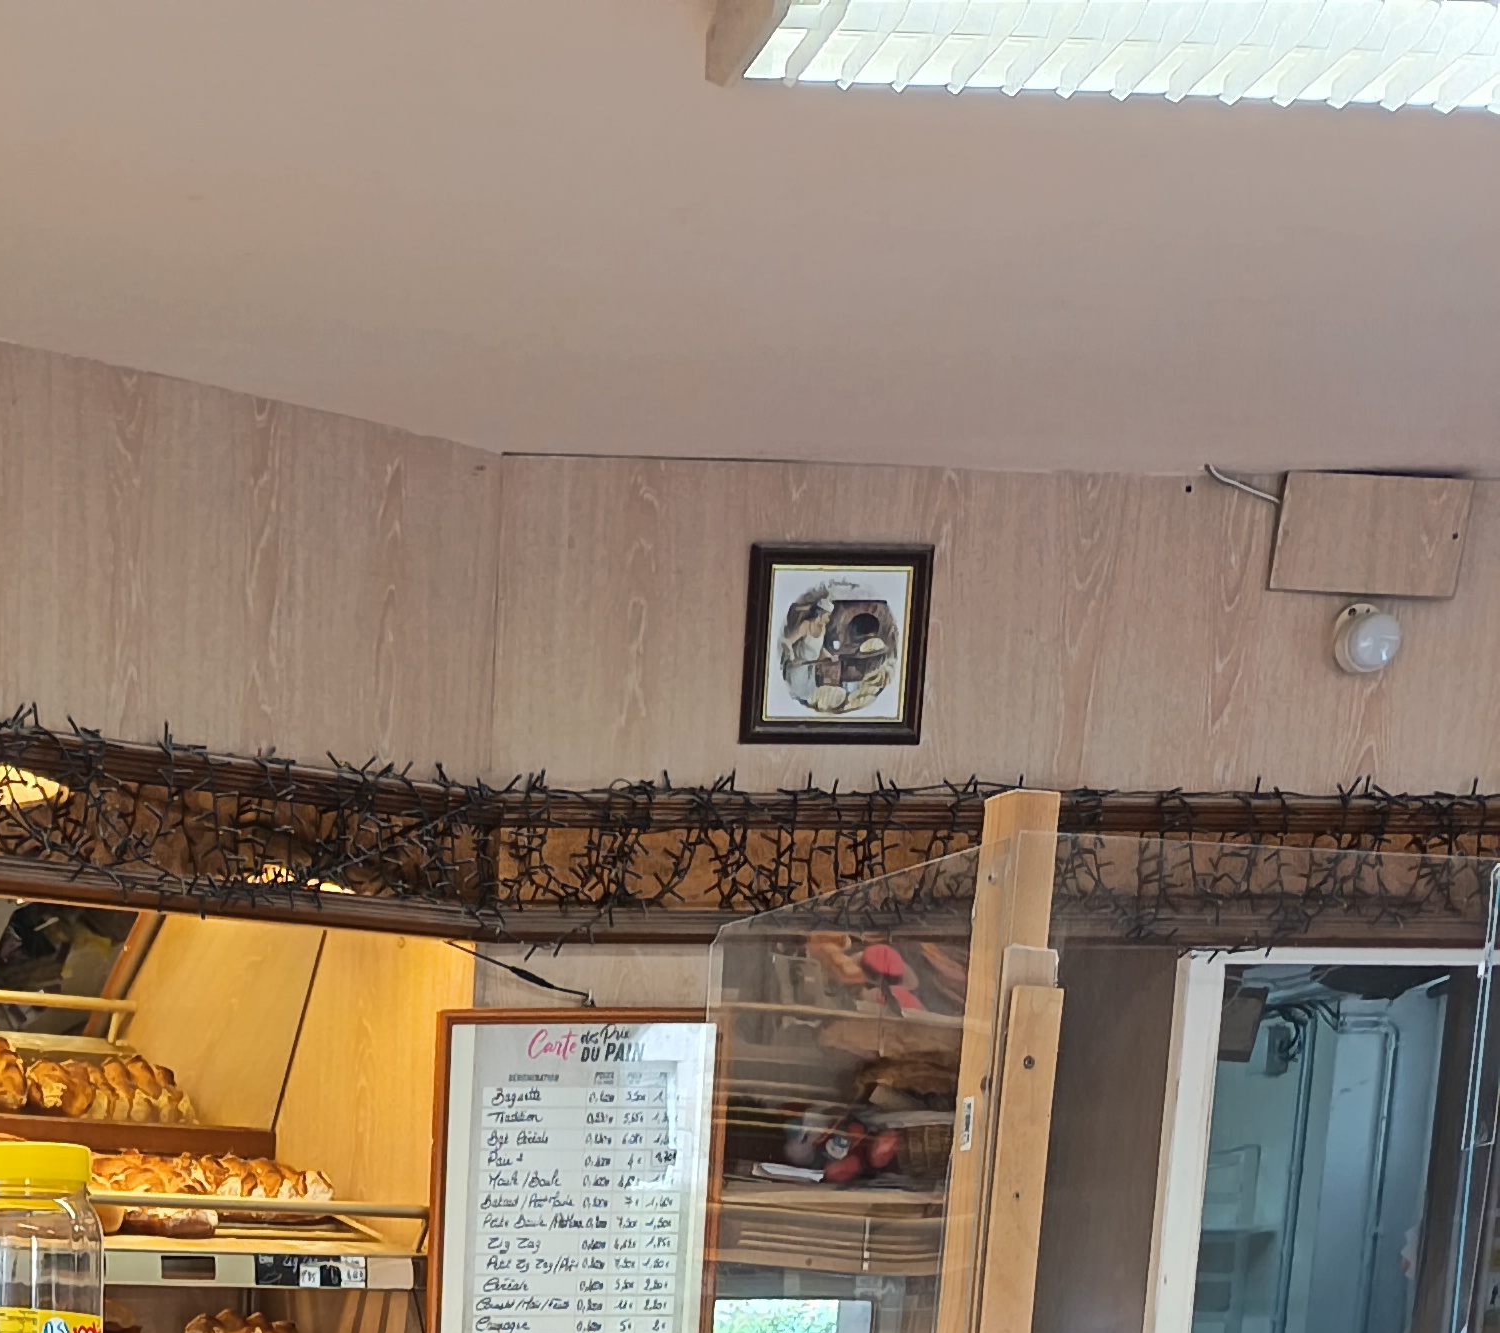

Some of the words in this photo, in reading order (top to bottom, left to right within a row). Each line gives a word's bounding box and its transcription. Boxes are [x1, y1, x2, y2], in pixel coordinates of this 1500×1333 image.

[528, 1029, 578, 1060] Carte
[581, 1047, 599, 1062] DU
[604, 1042, 645, 1062] PAIN
